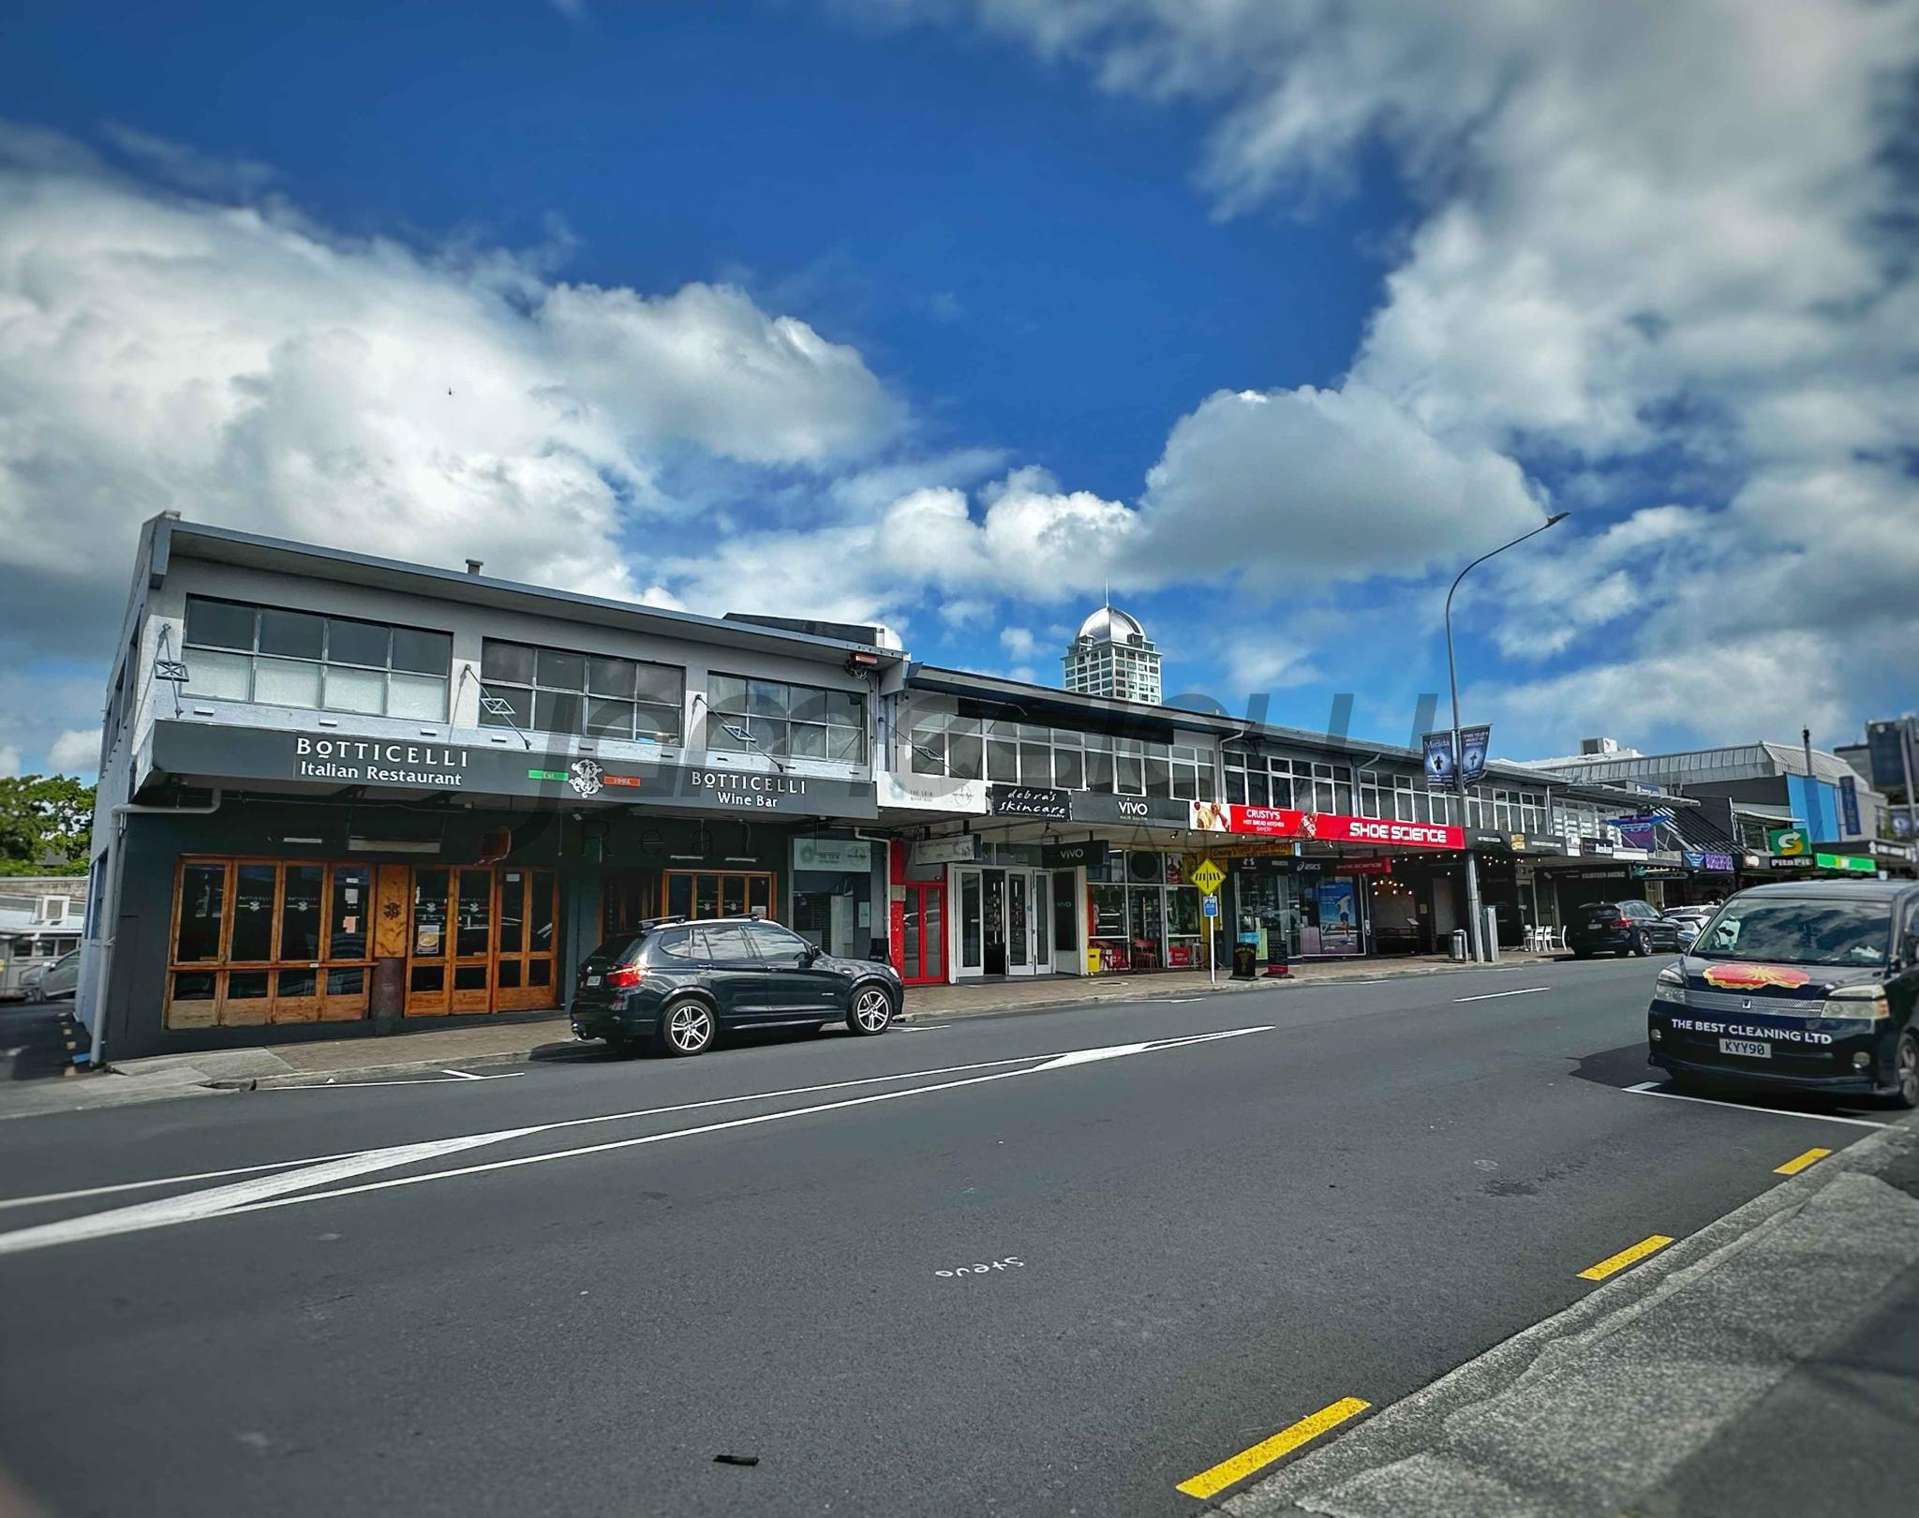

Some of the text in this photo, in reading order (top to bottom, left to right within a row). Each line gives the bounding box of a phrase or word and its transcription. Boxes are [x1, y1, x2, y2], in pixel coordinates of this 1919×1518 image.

[296, 737, 468, 768] BOTTICELLI
[300, 761, 462, 786] Italian Restaurant
[691, 771, 806, 794] BOTTICELLI
[717, 792, 778, 808] Wine Bar
[1007, 788, 1056, 802] debra's
[999, 800, 1066, 815] skincare
[1246, 809, 1281, 820] CRUSTY'S
[1349, 822, 1447, 843] SHOE SCIENCE
[1671, 1018, 1832, 1045] THE BEST CLEANING LTD
[1725, 1039, 1765, 1056] KYY90
